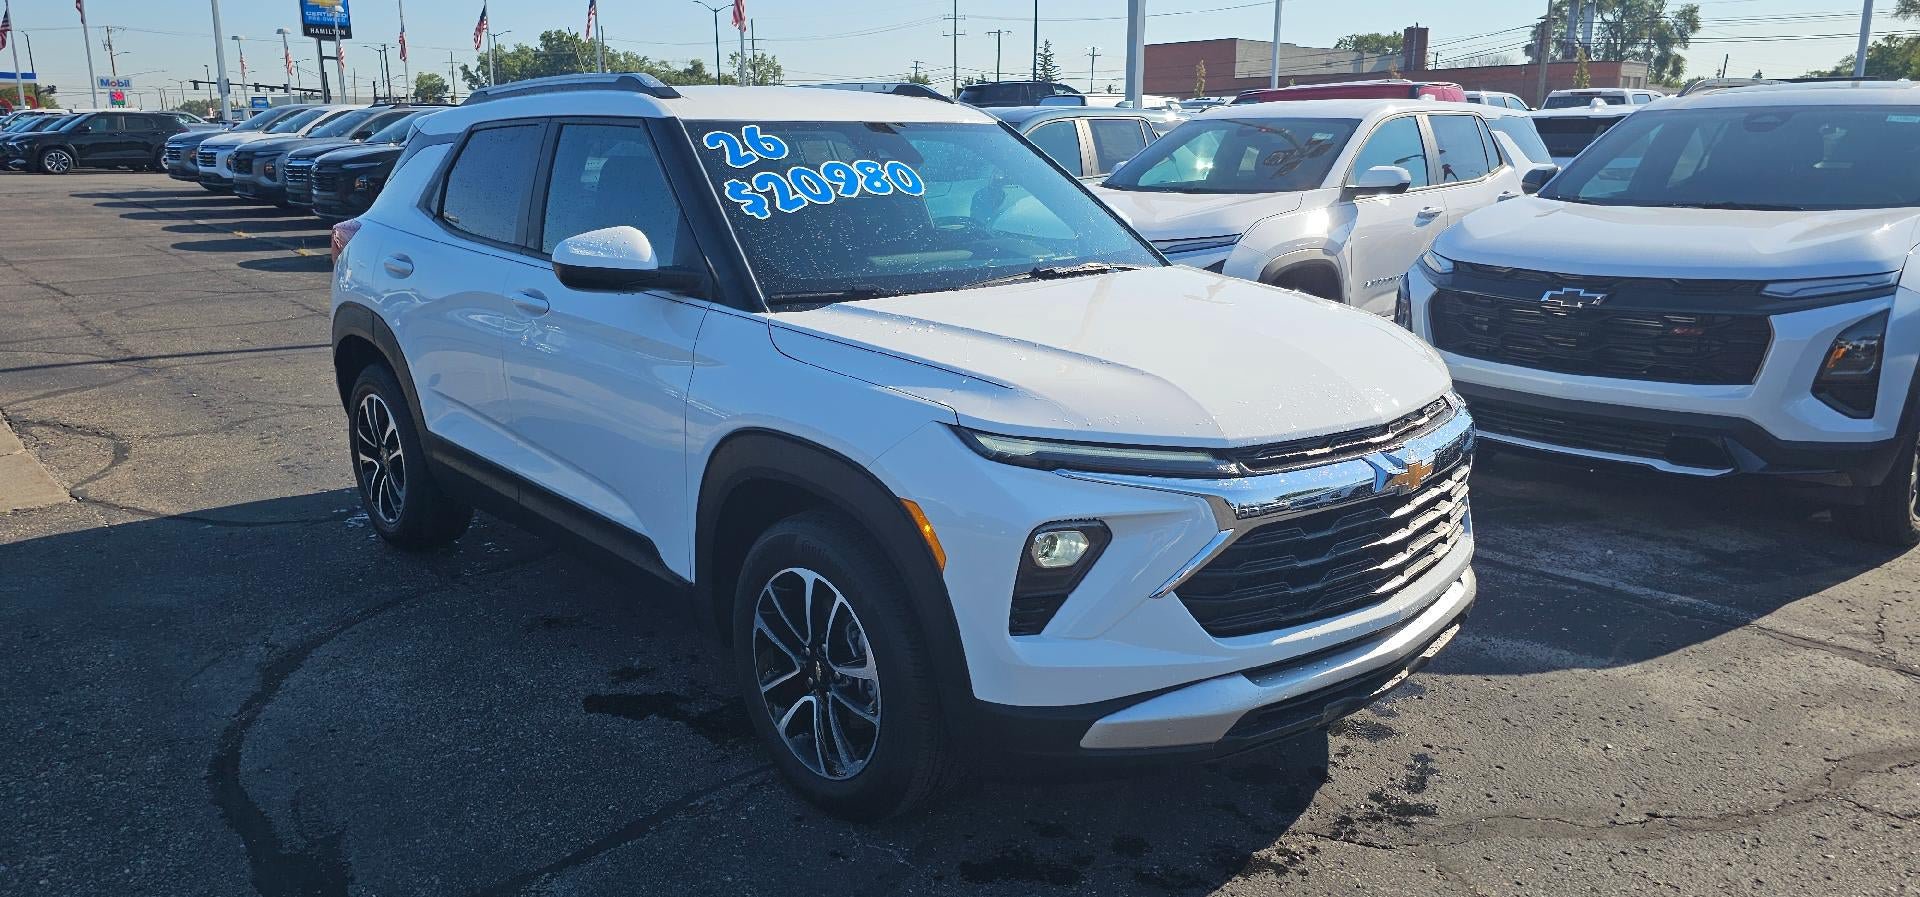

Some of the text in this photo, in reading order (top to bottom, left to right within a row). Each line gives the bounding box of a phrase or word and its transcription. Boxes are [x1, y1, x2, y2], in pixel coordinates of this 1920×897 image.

[100, 78, 130, 87] Mobil
[703, 125, 789, 168] 26
[724, 160, 925, 219] $20980
